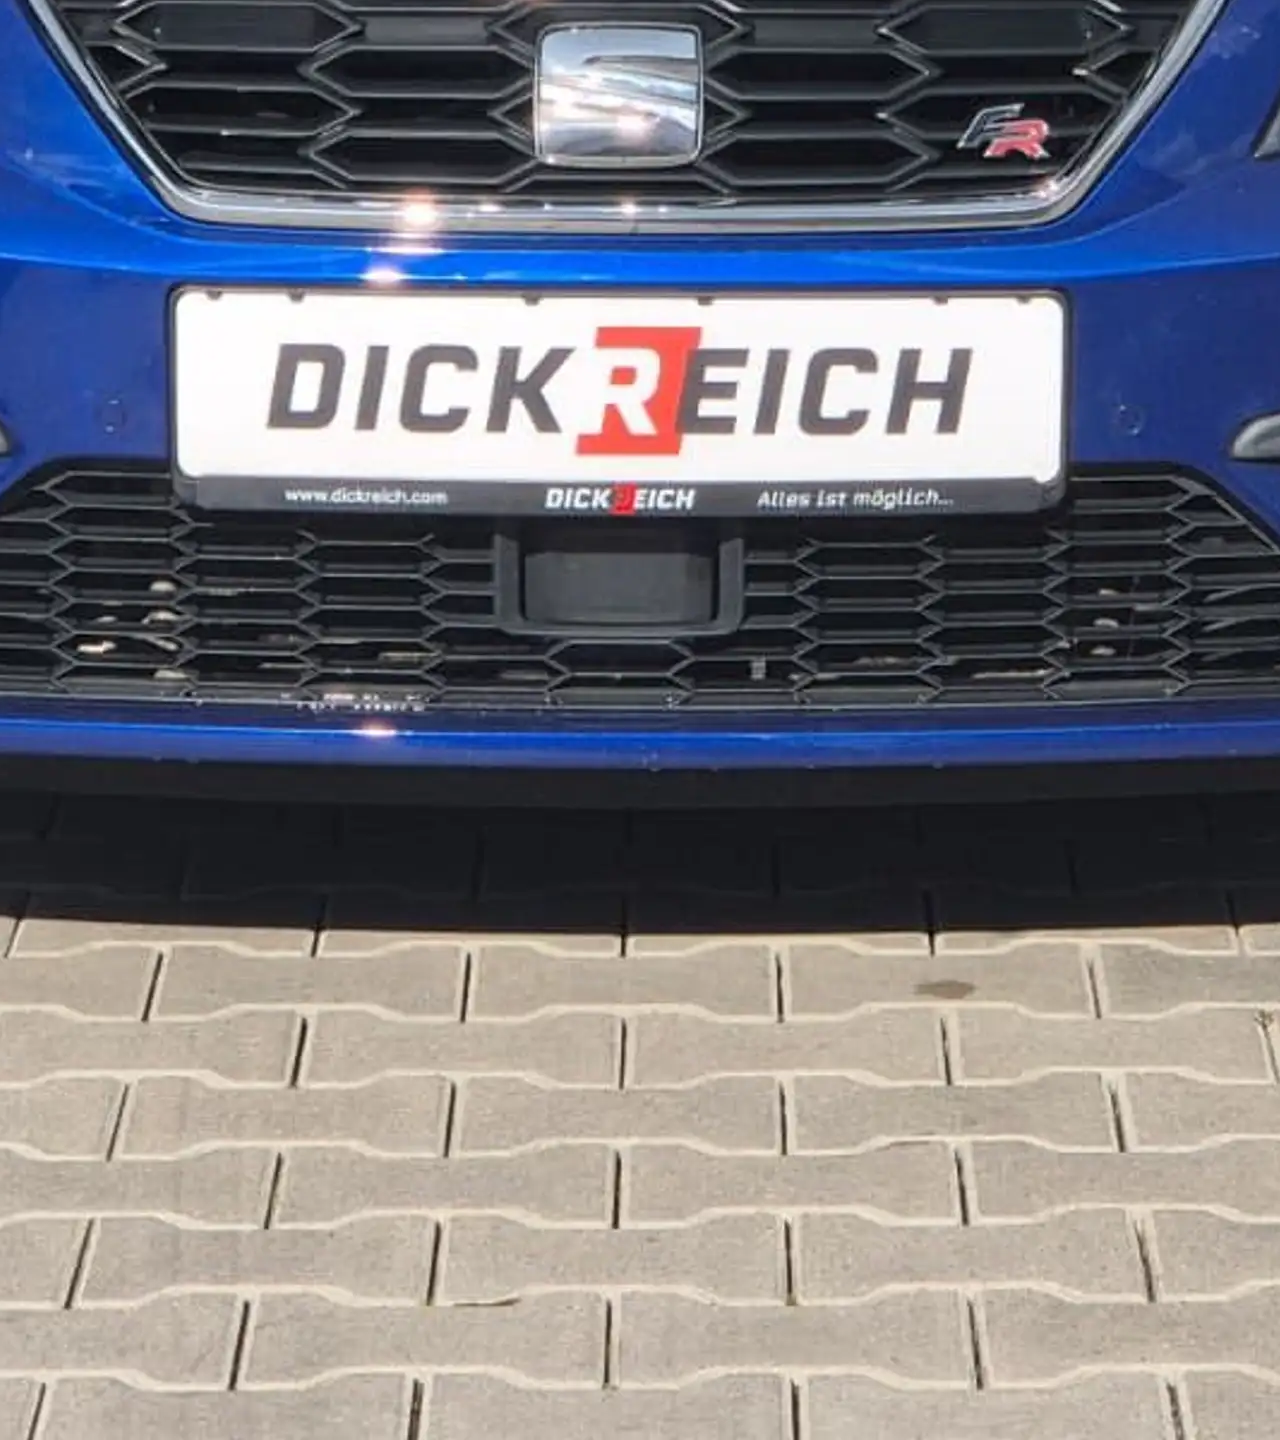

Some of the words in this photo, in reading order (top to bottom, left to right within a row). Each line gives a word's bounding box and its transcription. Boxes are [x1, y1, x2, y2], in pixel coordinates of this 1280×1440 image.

[266, 342, 974, 436] DICKREICH
[285, 487, 449, 506] www.dickreich.com
[757, 489, 811, 508] Alles
